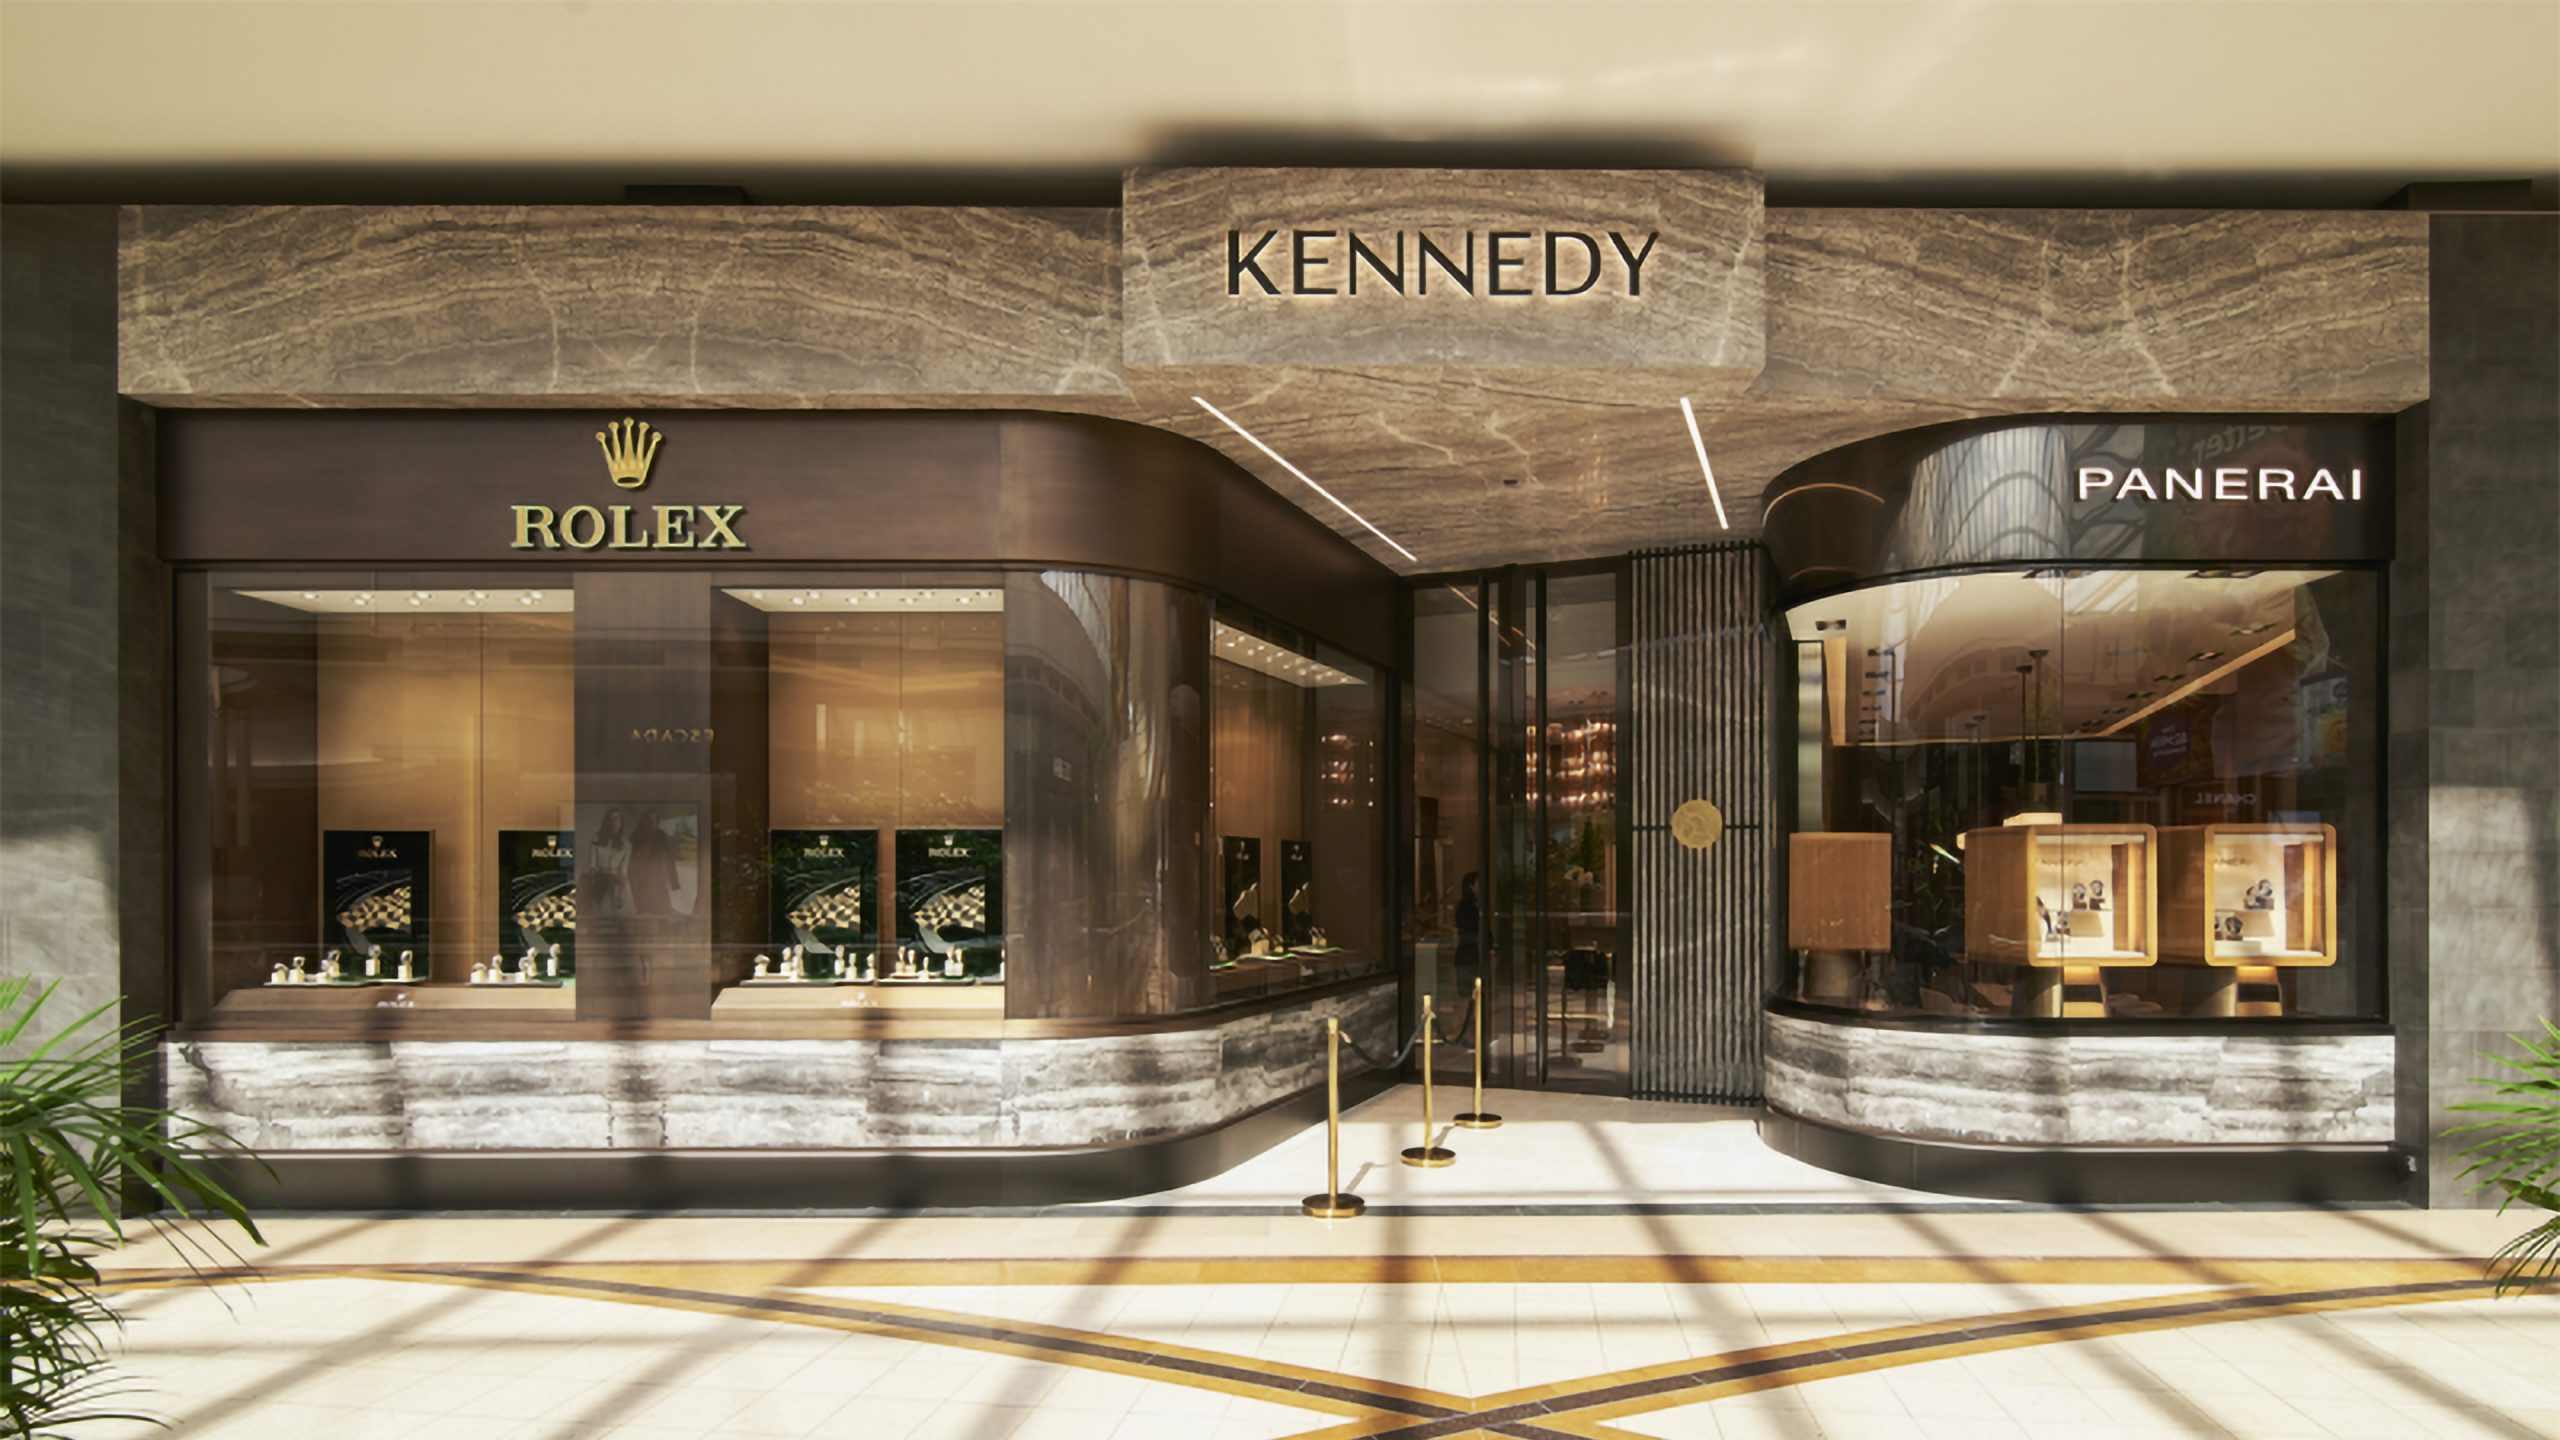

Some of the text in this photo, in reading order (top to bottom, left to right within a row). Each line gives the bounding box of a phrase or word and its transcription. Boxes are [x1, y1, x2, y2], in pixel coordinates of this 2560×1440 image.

[1228, 229, 1658, 296] KENNEDY
[2078, 467, 2361, 500] PANERAI
[510, 505, 747, 548] ROLEX
[531, 847, 574, 858] ROLEX
[803, 847, 845, 858] ROLEX
[928, 847, 972, 858] ROLEX
